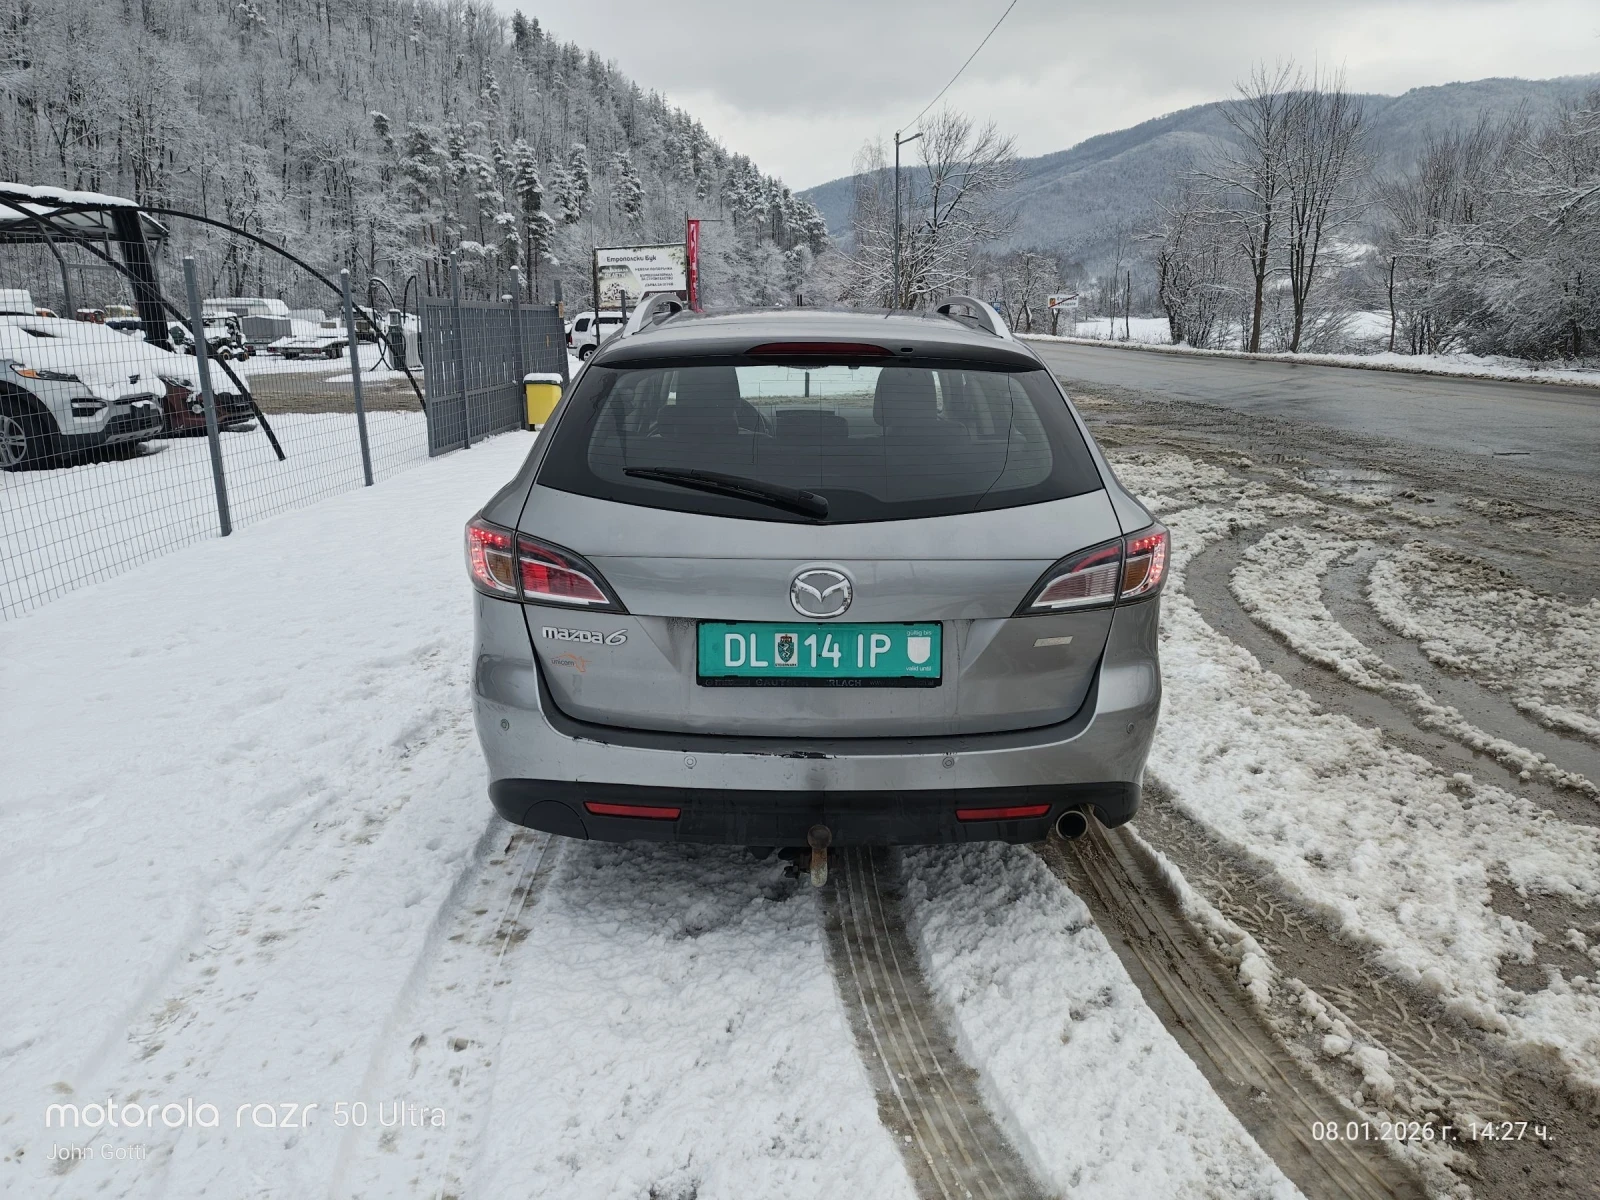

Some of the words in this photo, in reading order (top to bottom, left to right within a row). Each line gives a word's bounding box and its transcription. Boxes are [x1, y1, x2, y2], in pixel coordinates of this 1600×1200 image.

[724, 633, 769, 668] DL
[803, 633, 842, 668] 14
[857, 633, 892, 668] IP
